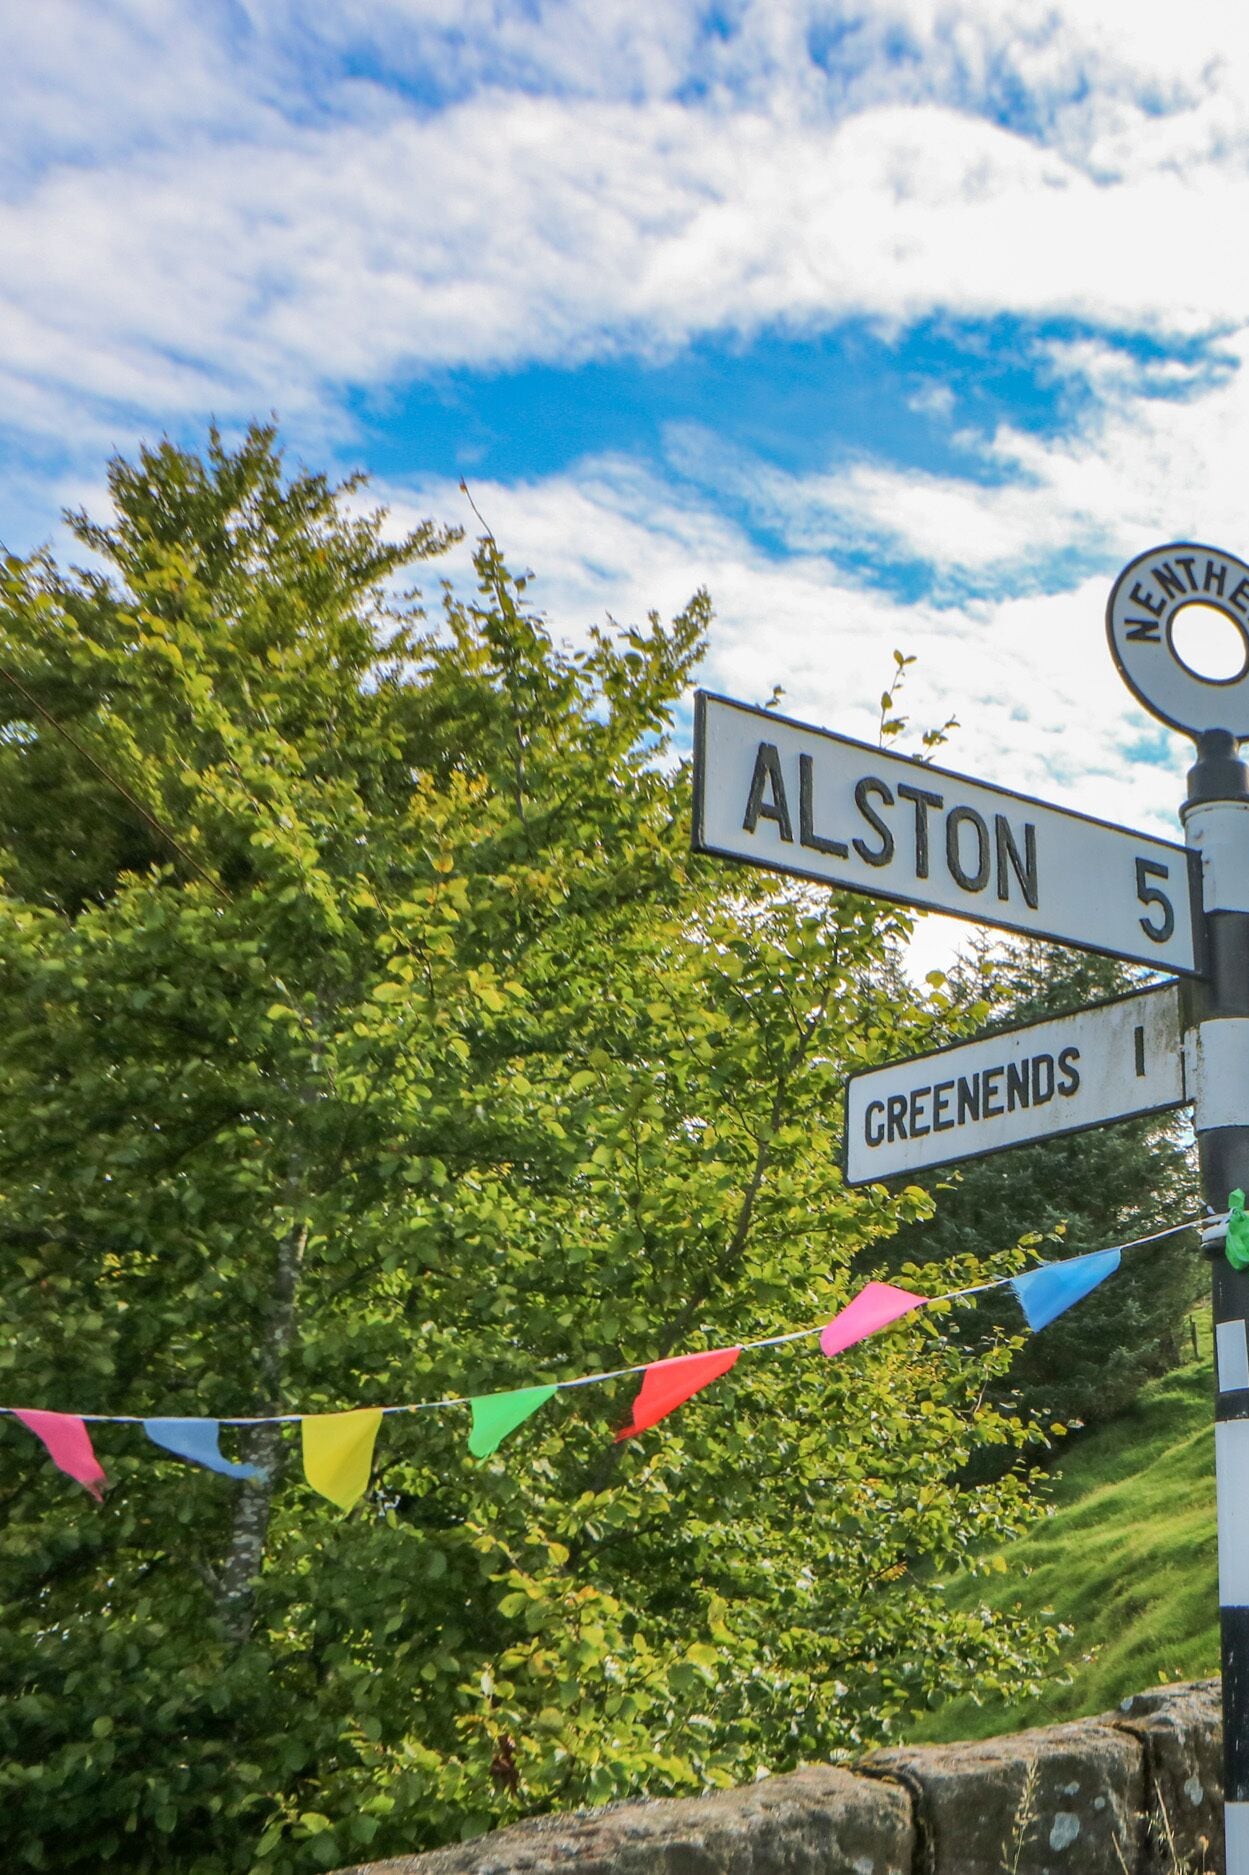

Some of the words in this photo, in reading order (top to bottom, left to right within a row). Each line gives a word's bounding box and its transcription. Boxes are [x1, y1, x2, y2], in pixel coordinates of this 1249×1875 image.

[742, 742, 1039, 910] ALSTON
[1135, 857, 1175, 944] 5
[864, 1047, 1081, 1148] GREENENDS
